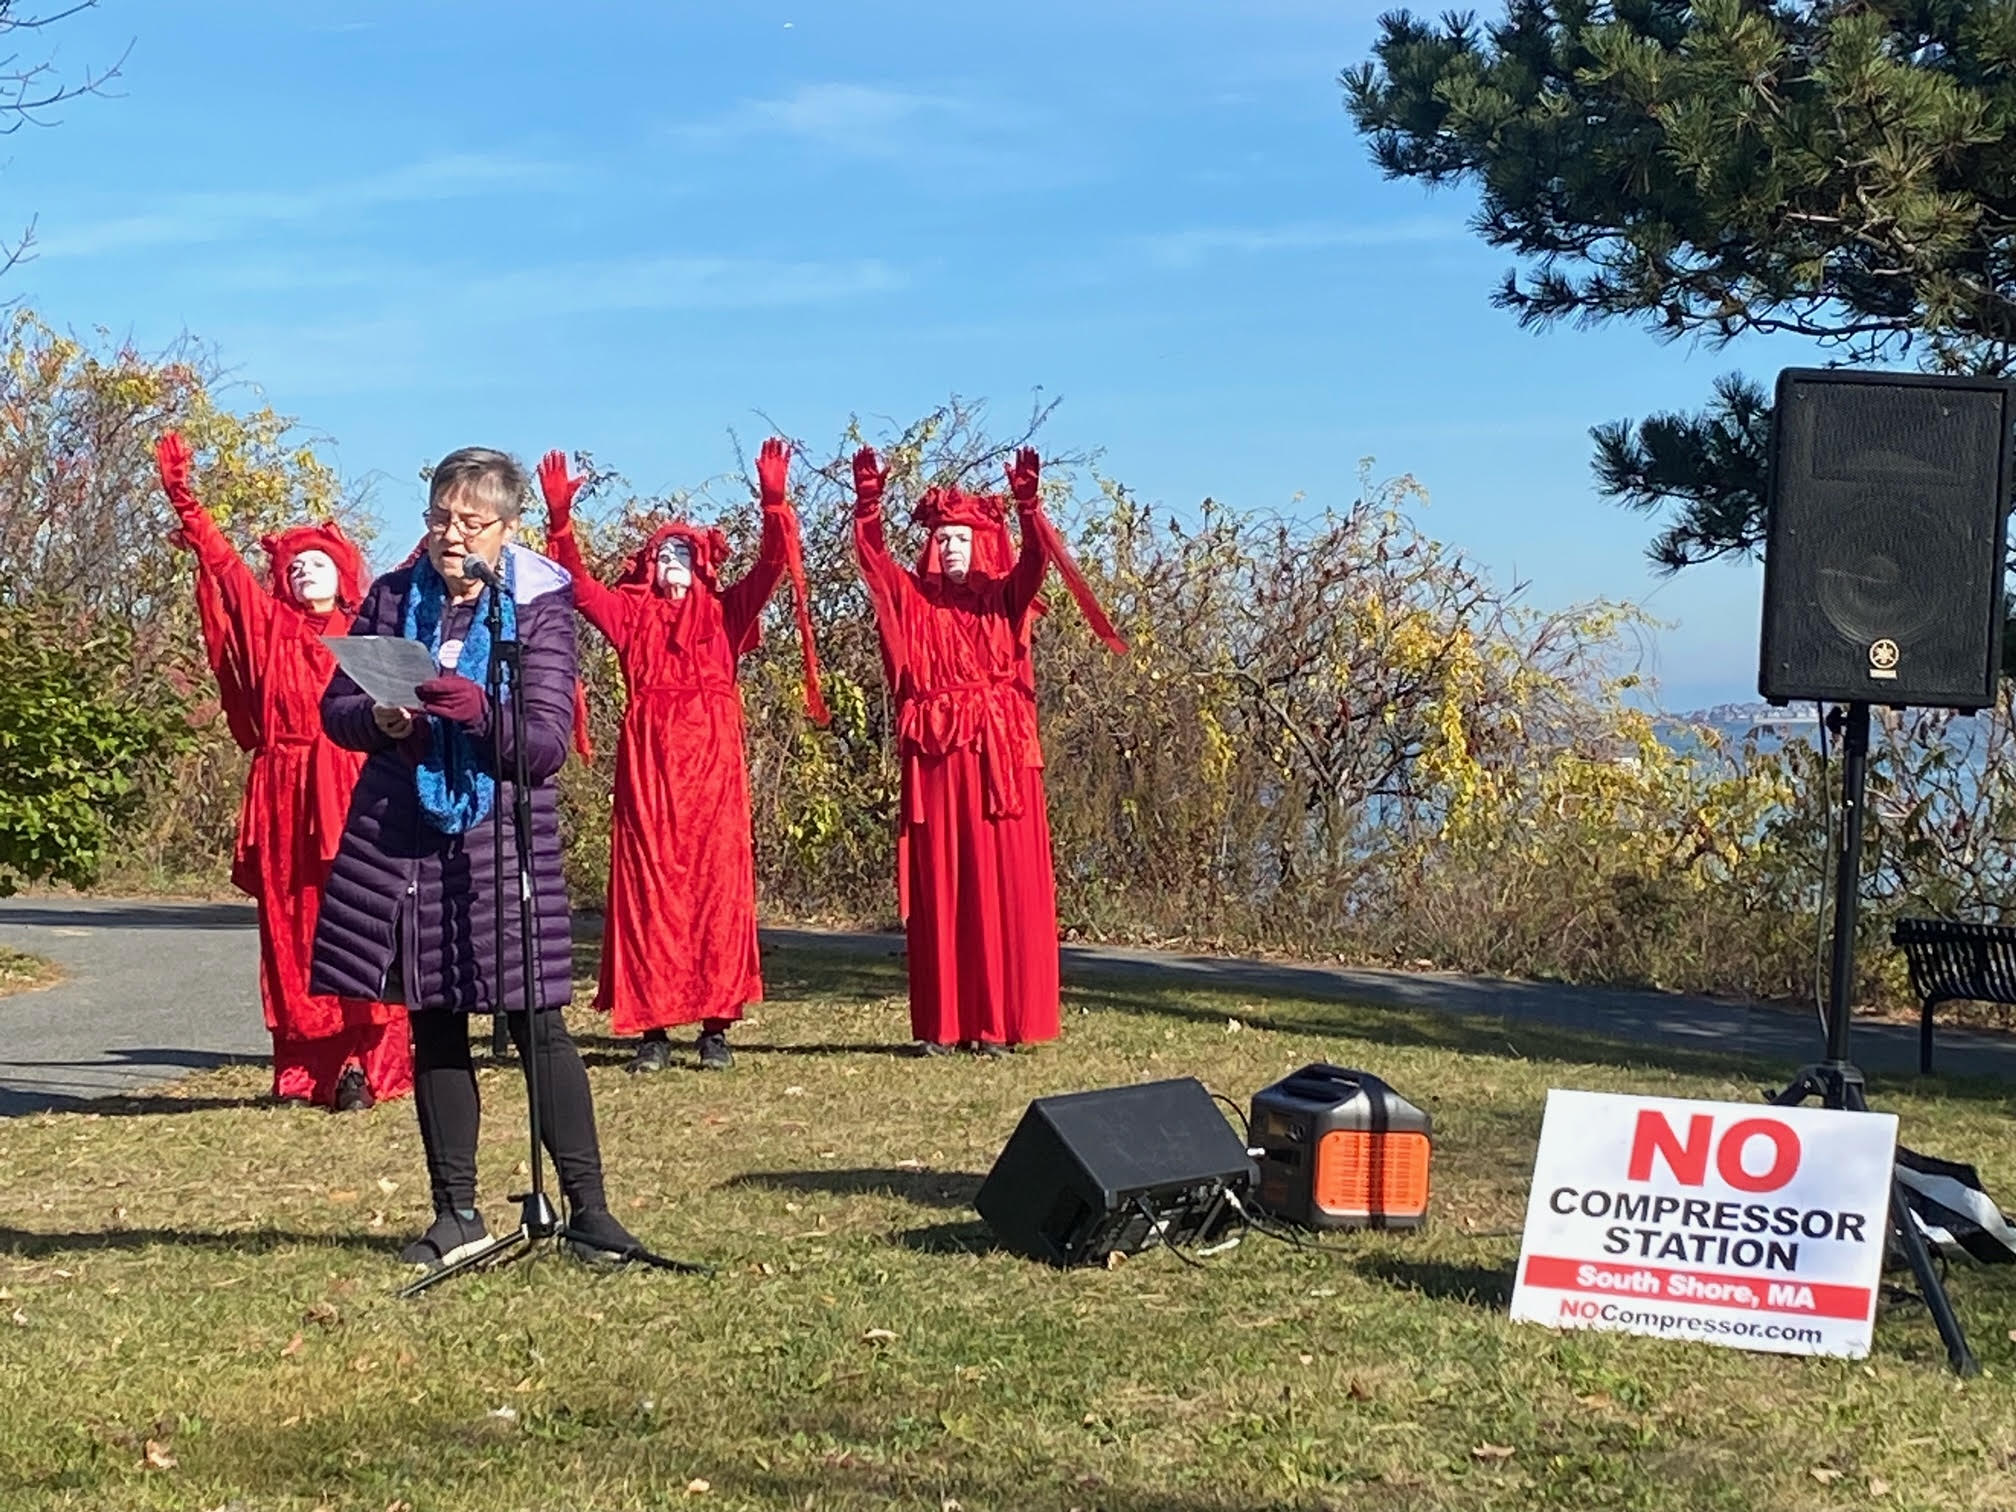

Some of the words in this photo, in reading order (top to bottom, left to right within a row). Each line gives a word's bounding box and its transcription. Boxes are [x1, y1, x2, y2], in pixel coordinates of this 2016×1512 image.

[1628, 1109, 1801, 1192] NO
[1550, 1187, 1866, 1242] COMPRESSOR
[1603, 1227, 1799, 1272] STATION
[1577, 1265, 1660, 1295] South
[1667, 1275, 1760, 1309] Shore,
[1768, 1284, 1816, 1310] MA
[1560, 1299, 1822, 1344] NOCompressor.com
